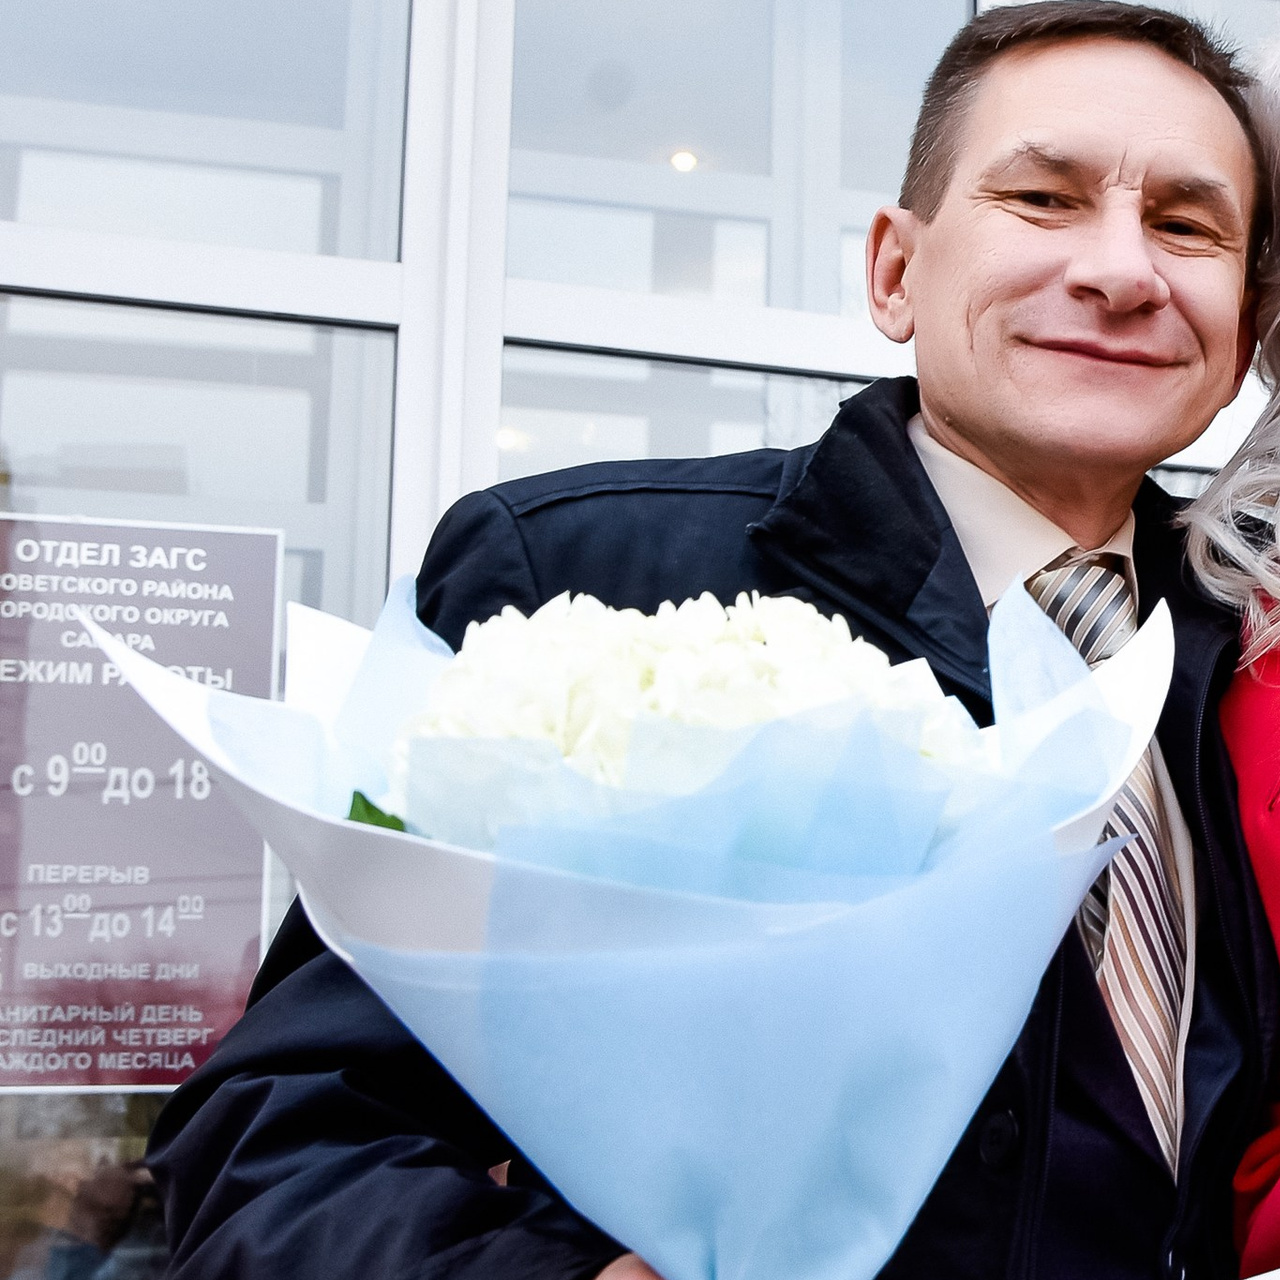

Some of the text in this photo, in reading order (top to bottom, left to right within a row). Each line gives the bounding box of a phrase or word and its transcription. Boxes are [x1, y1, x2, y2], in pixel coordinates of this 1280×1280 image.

[16, 539, 207, 571] ОТДЕЛ ЗАГС
[0, 573, 234, 601] ОВЕТСКОГО РАЙОНА
[0, 600, 229, 627] ОРОДСКОГО ОКРУГА
[0, 659, 93, 685] ЕЖИМ
[169, 758, 211, 800] 18
[27, 864, 150, 884] ПЕРЕРЫВ
[24, 962, 200, 982] ВЫХОДНЫЕ ДНИ
[0, 1002, 203, 1024] НИТАРНЫЙ ДЕНЬ
[0, 1025, 212, 1048] СЛЕДНИЙ ЧЕТВЕРГ
[0, 1052, 195, 1073] АЖДОГО МЕСЯЦА
